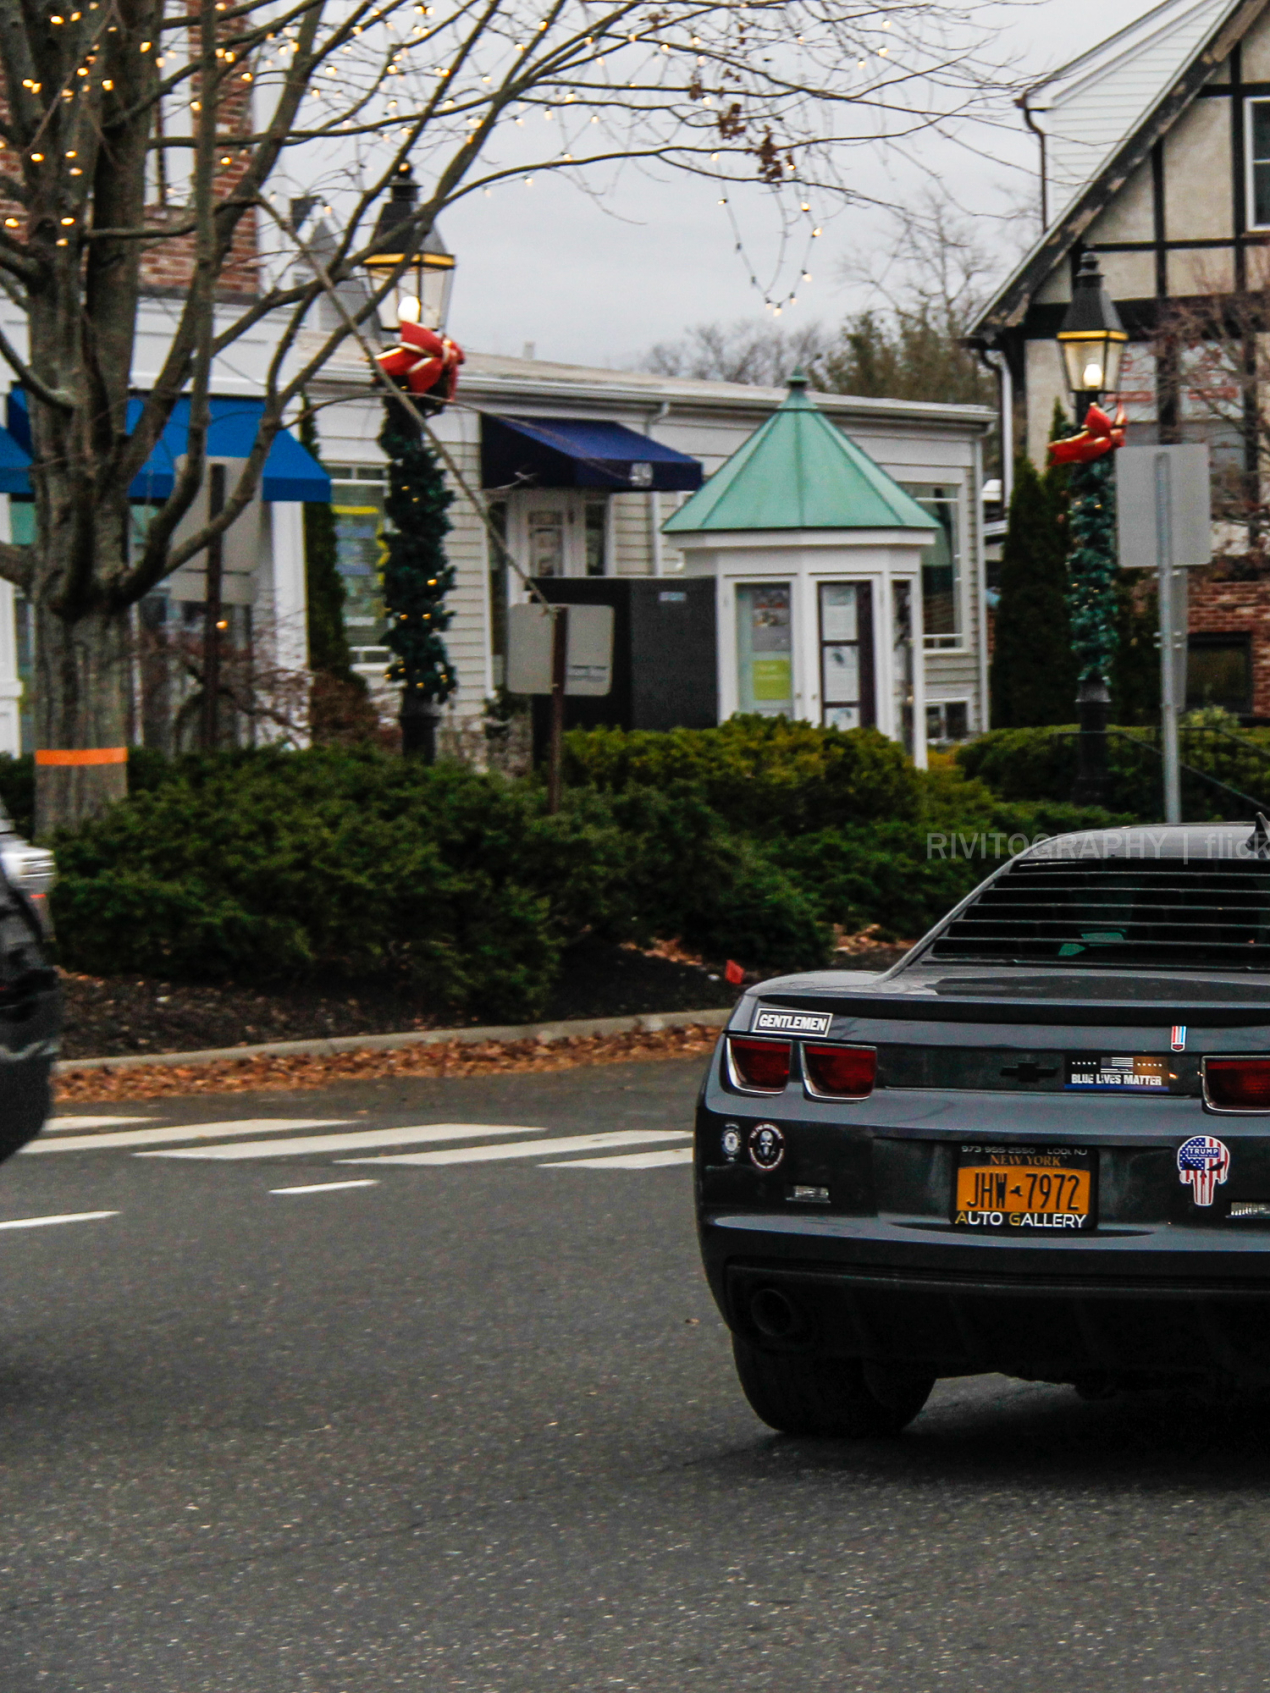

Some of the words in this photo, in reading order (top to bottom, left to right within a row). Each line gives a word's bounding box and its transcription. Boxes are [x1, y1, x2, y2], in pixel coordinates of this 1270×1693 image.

[758, 1014, 828, 1031] GENTLEMEN
[1071, 1073, 1094, 1084] BLUE
[1096, 1074, 1121, 1084] LIVES
[1123, 1074, 1162, 1086] MATTER
[1074, 1148, 1088, 1156] NJ
[990, 1155, 1022, 1166] NEW
[1025, 1155, 1062, 1167] YORK
[955, 1211, 1003, 1226] AUTO
[1008, 1212, 1087, 1229] GALLERY
